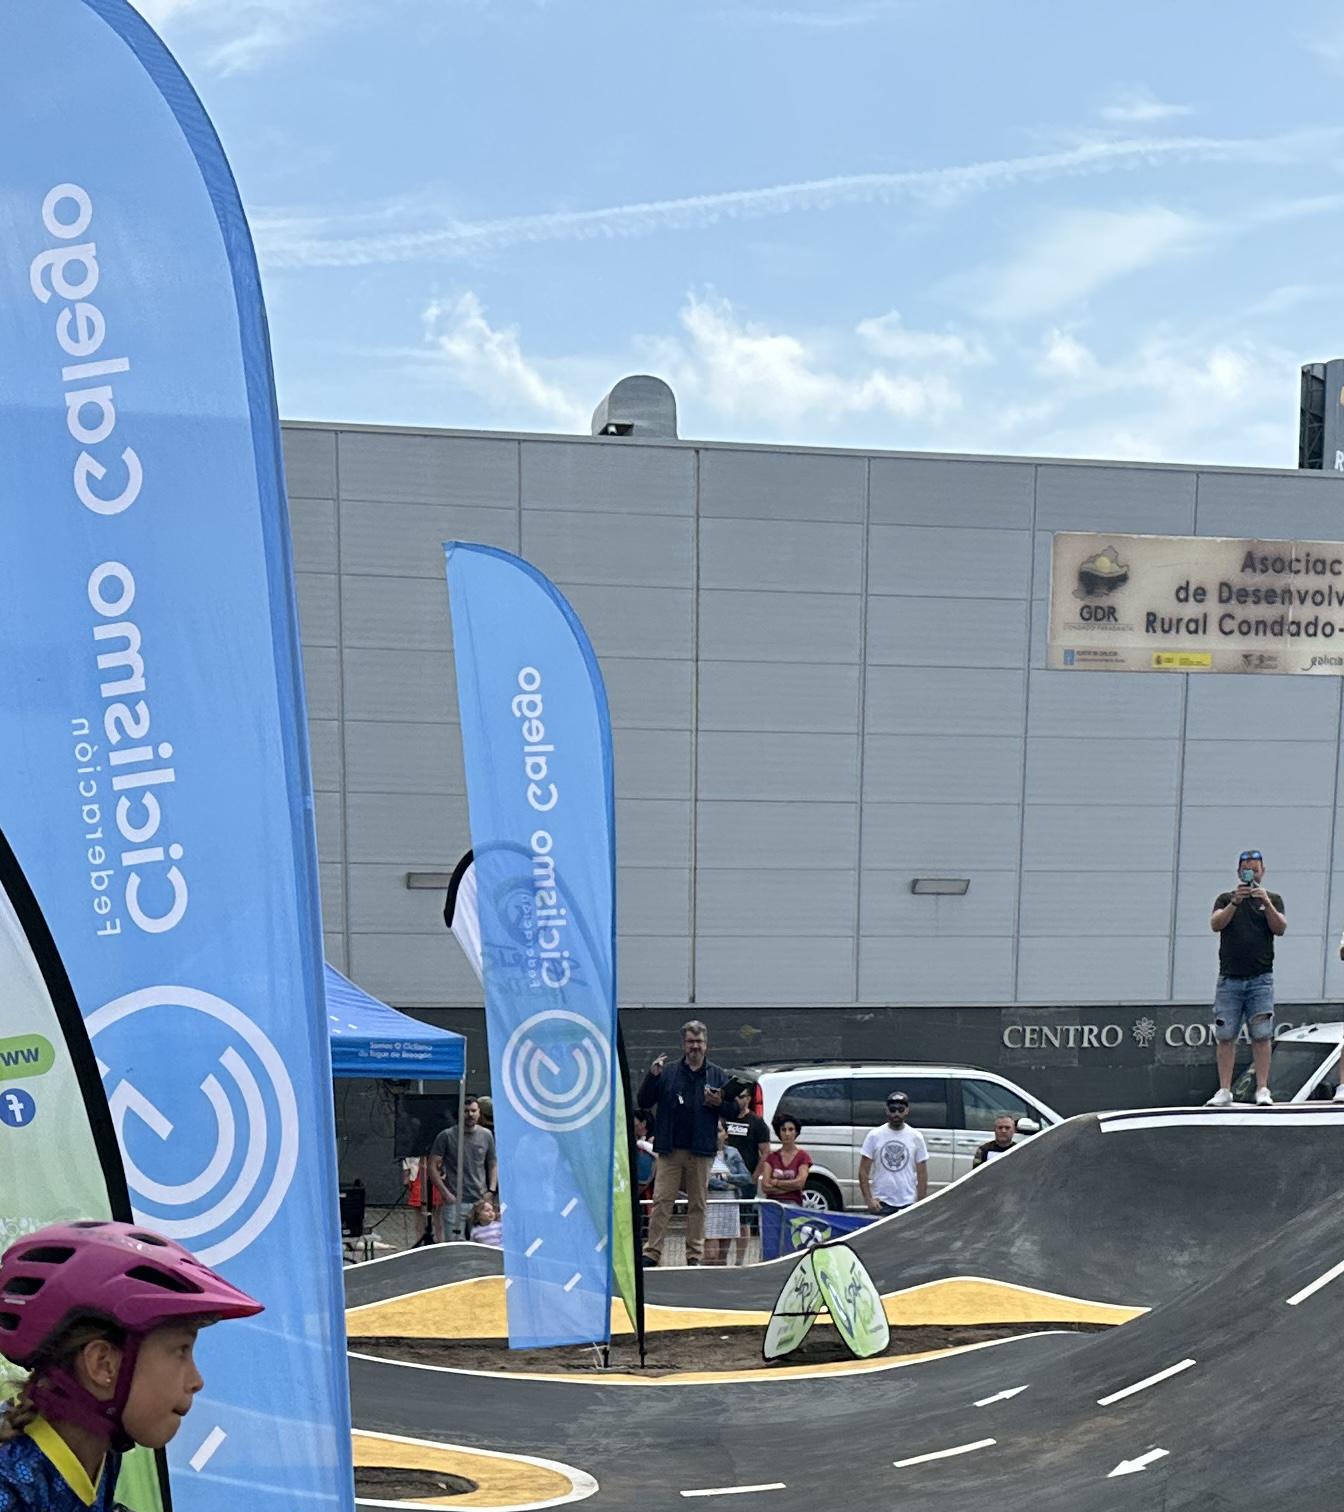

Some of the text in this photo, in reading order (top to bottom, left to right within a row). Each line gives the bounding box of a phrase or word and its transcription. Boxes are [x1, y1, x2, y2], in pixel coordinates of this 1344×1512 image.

[1174, 580, 1207, 604] de
[1079, 605, 1119, 624] GDR
[1145, 611, 1208, 636] Rural
[1002, 1023, 1123, 1049] CENTRO
